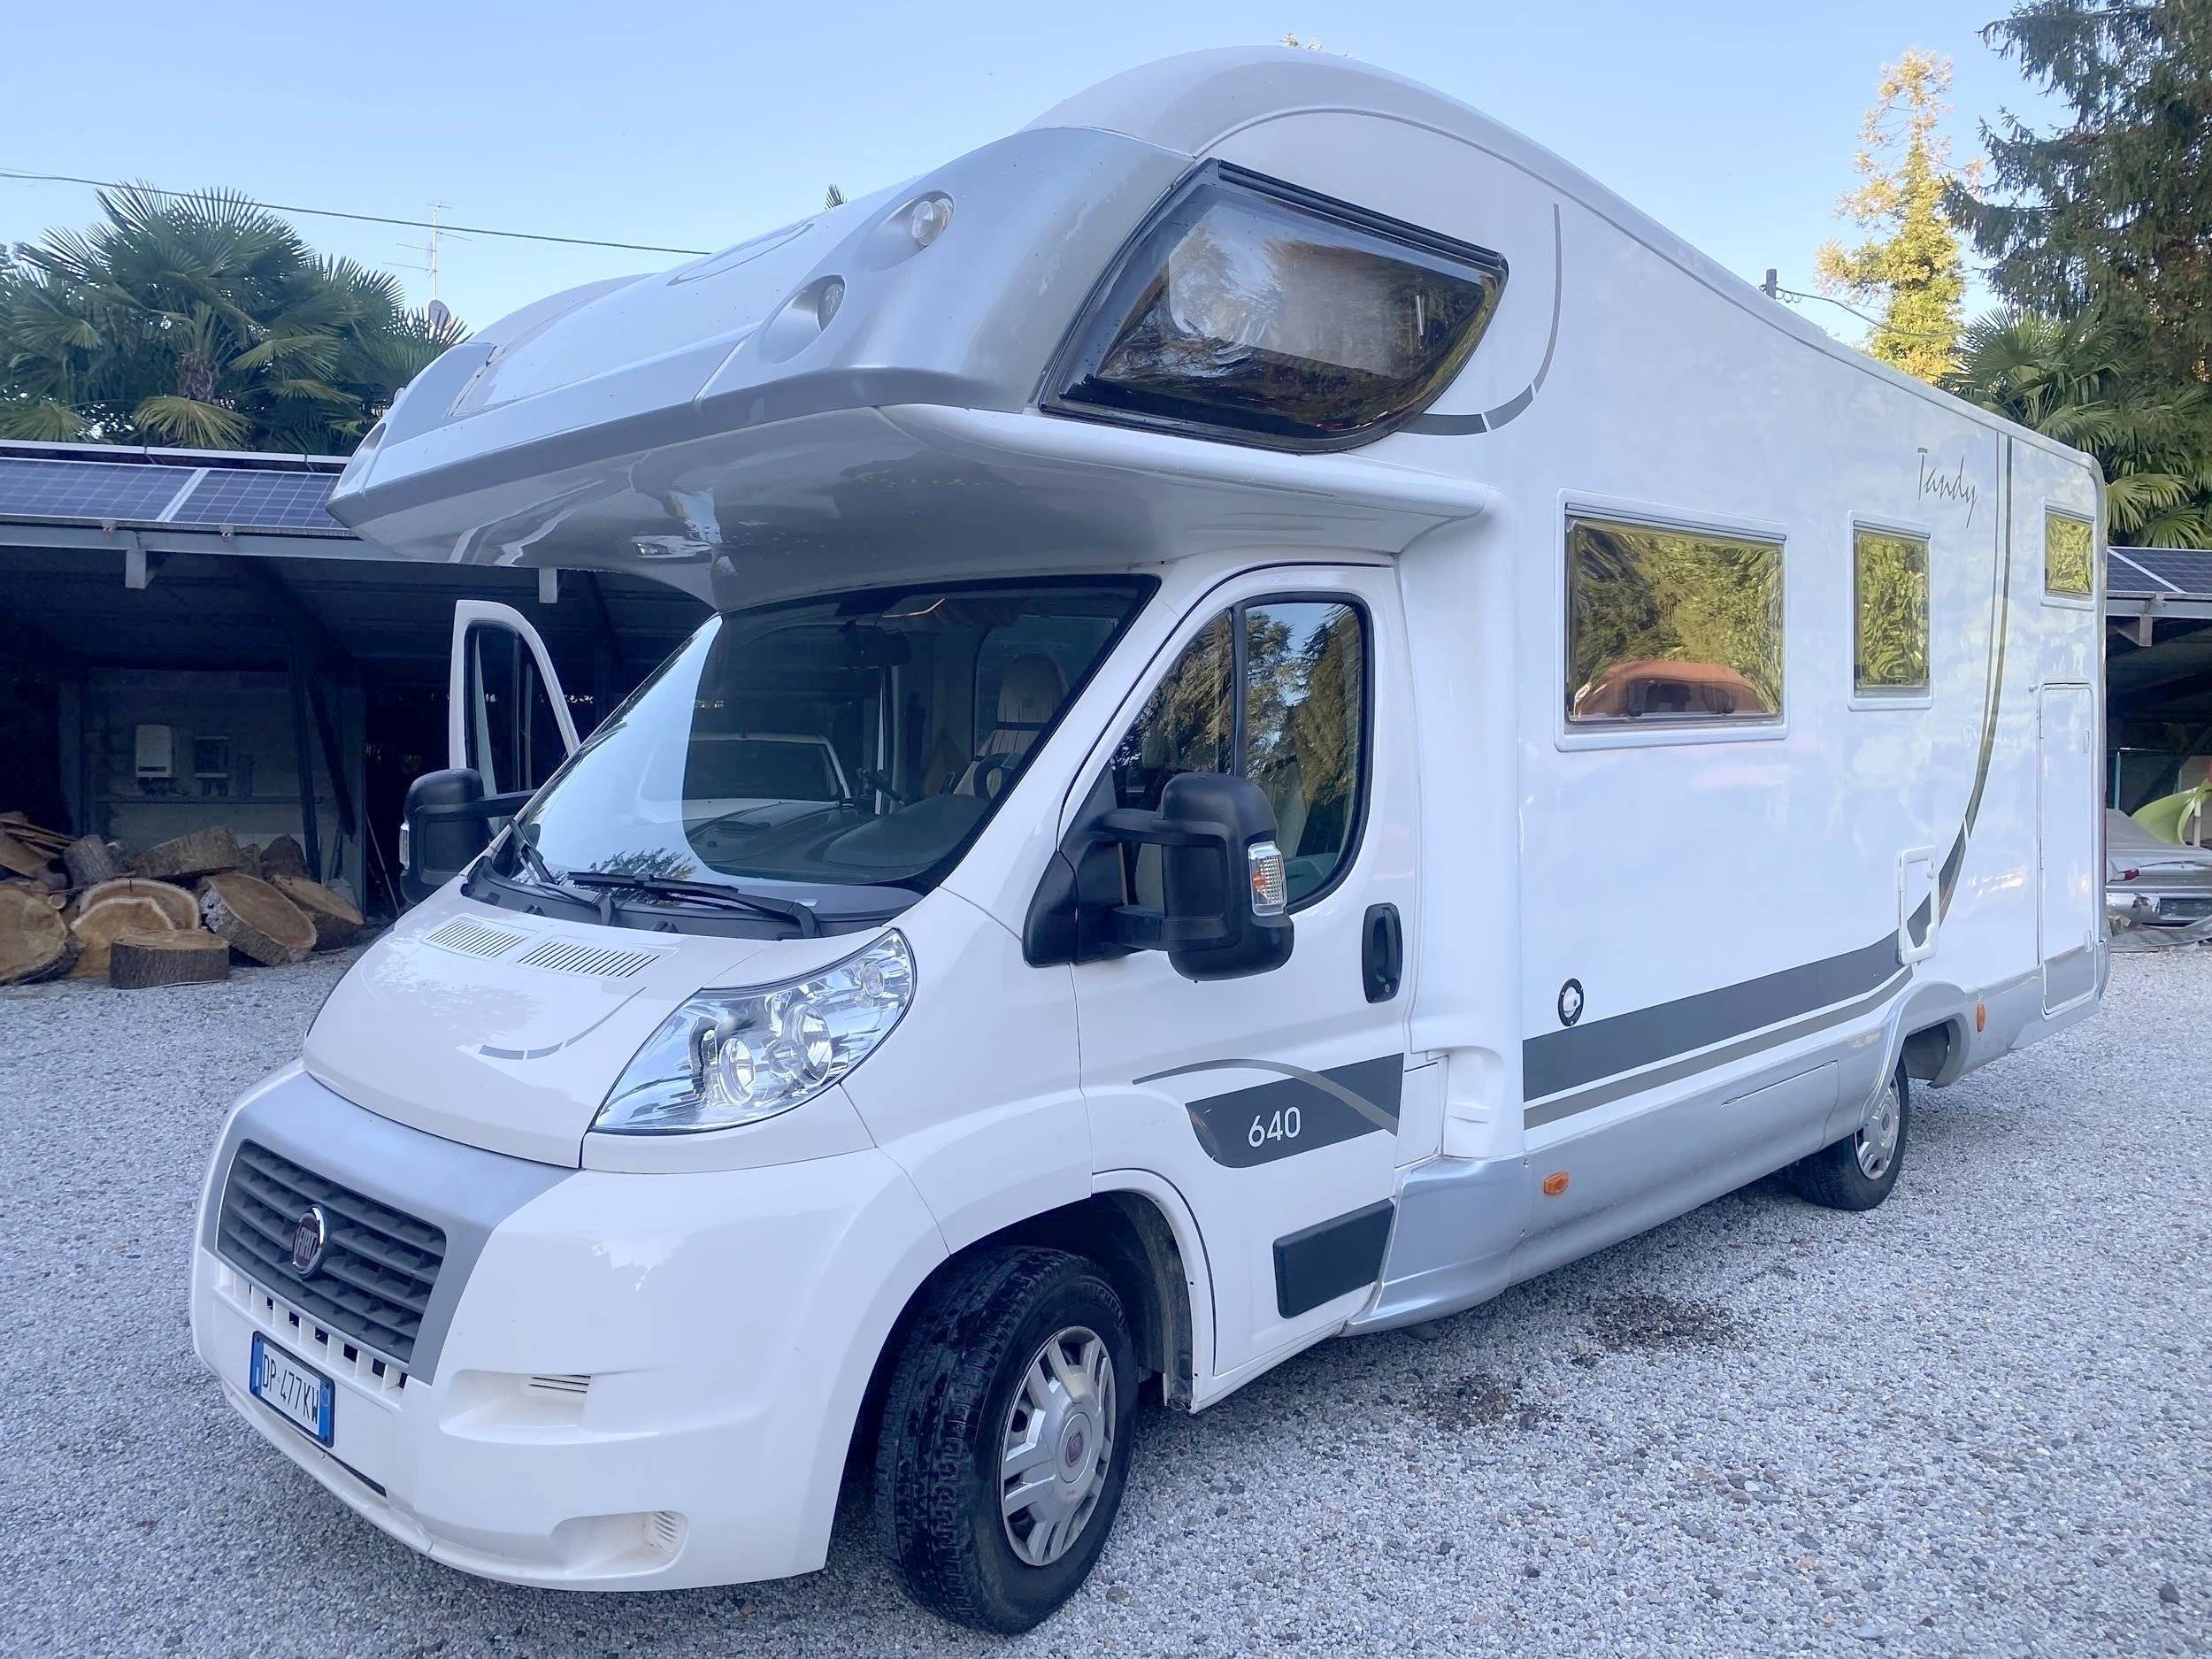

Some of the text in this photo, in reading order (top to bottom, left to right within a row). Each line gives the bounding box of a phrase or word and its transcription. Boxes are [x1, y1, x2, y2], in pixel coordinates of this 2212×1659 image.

[1916, 447, 1978, 529] Tandy
[1248, 1106, 1301, 1148] 640
[296, 1226, 318, 1261] FIAT
[263, 1353, 319, 1425] DP 477KW
